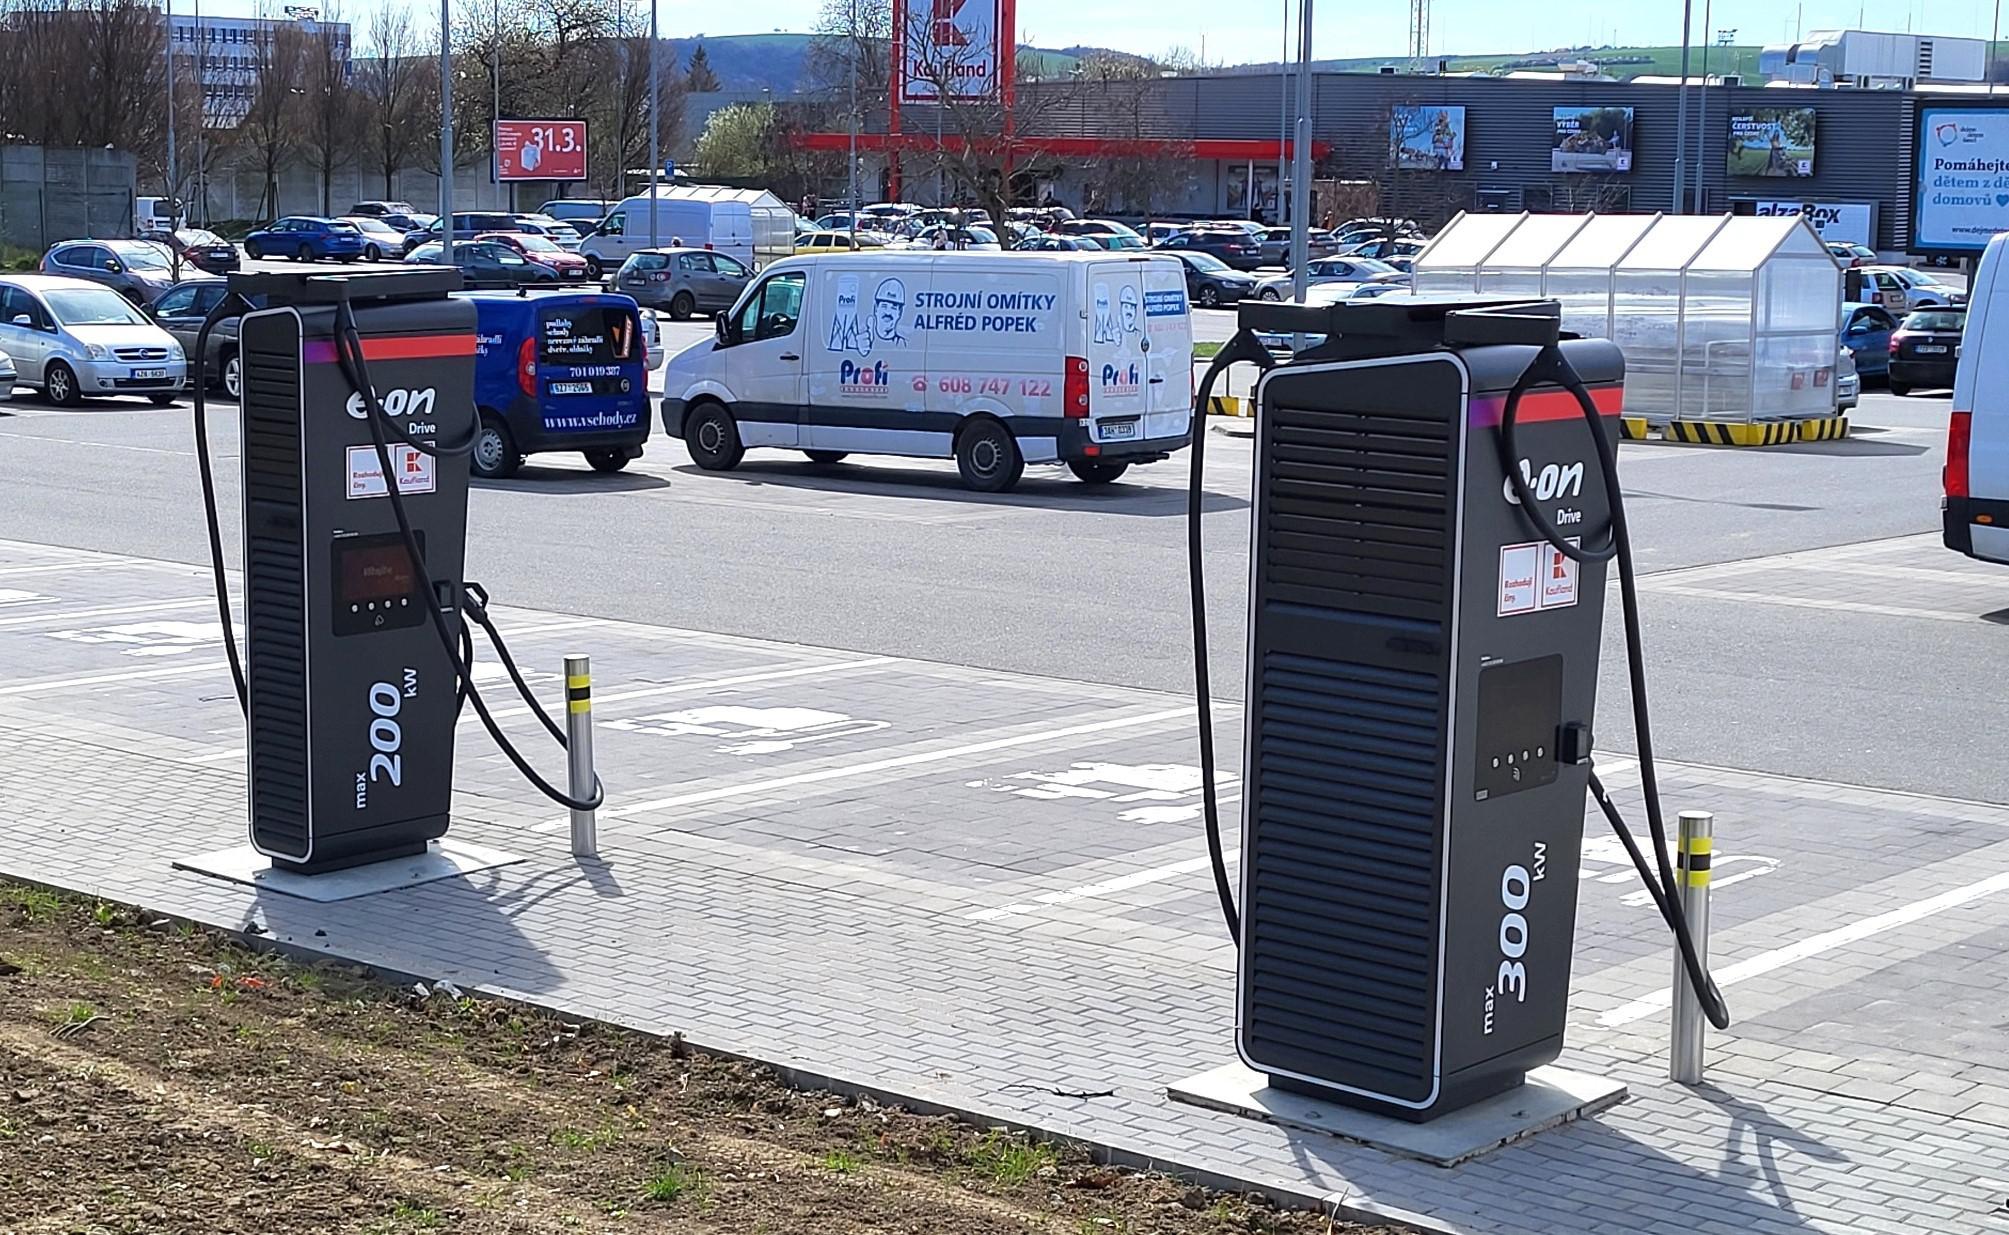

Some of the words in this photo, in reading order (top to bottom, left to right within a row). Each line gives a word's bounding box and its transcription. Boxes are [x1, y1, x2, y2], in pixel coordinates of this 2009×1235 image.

[531, 127, 582, 152] 31.3.
[1933, 175, 1979, 189] dětem
[1983, 180, 1991, 189] z
[1932, 192, 1992, 206] domovů
[838, 295, 856, 305] Profi
[914, 290, 983, 309] STROJNÍ
[987, 290, 1056, 311] OMÍTKY
[914, 312, 977, 331] ALFRÉD
[981, 316, 1037, 332] POPEK
[569, 367, 587, 377] 701
[840, 359, 889, 386] Profi
[1102, 362, 1139, 387] Profi
[938, 378, 972, 394] 608
[978, 378, 1011, 396] 747
[1020, 379, 1052, 397] 122
[409, 422, 436, 434] Drive
[544, 411, 637, 428] www.vschody.cz
[399, 475, 430, 485] Kaufland
[1557, 507, 1582, 526] Drive
[1545, 583, 1573, 596] Kaufland
[403, 667, 418, 699] kW
[369, 681, 402, 787] 200
[355, 772, 367, 809] max
[1532, 841, 1548, 882] kW
[1498, 864, 1531, 1003] 300
[1484, 985, 1495, 1035] max
